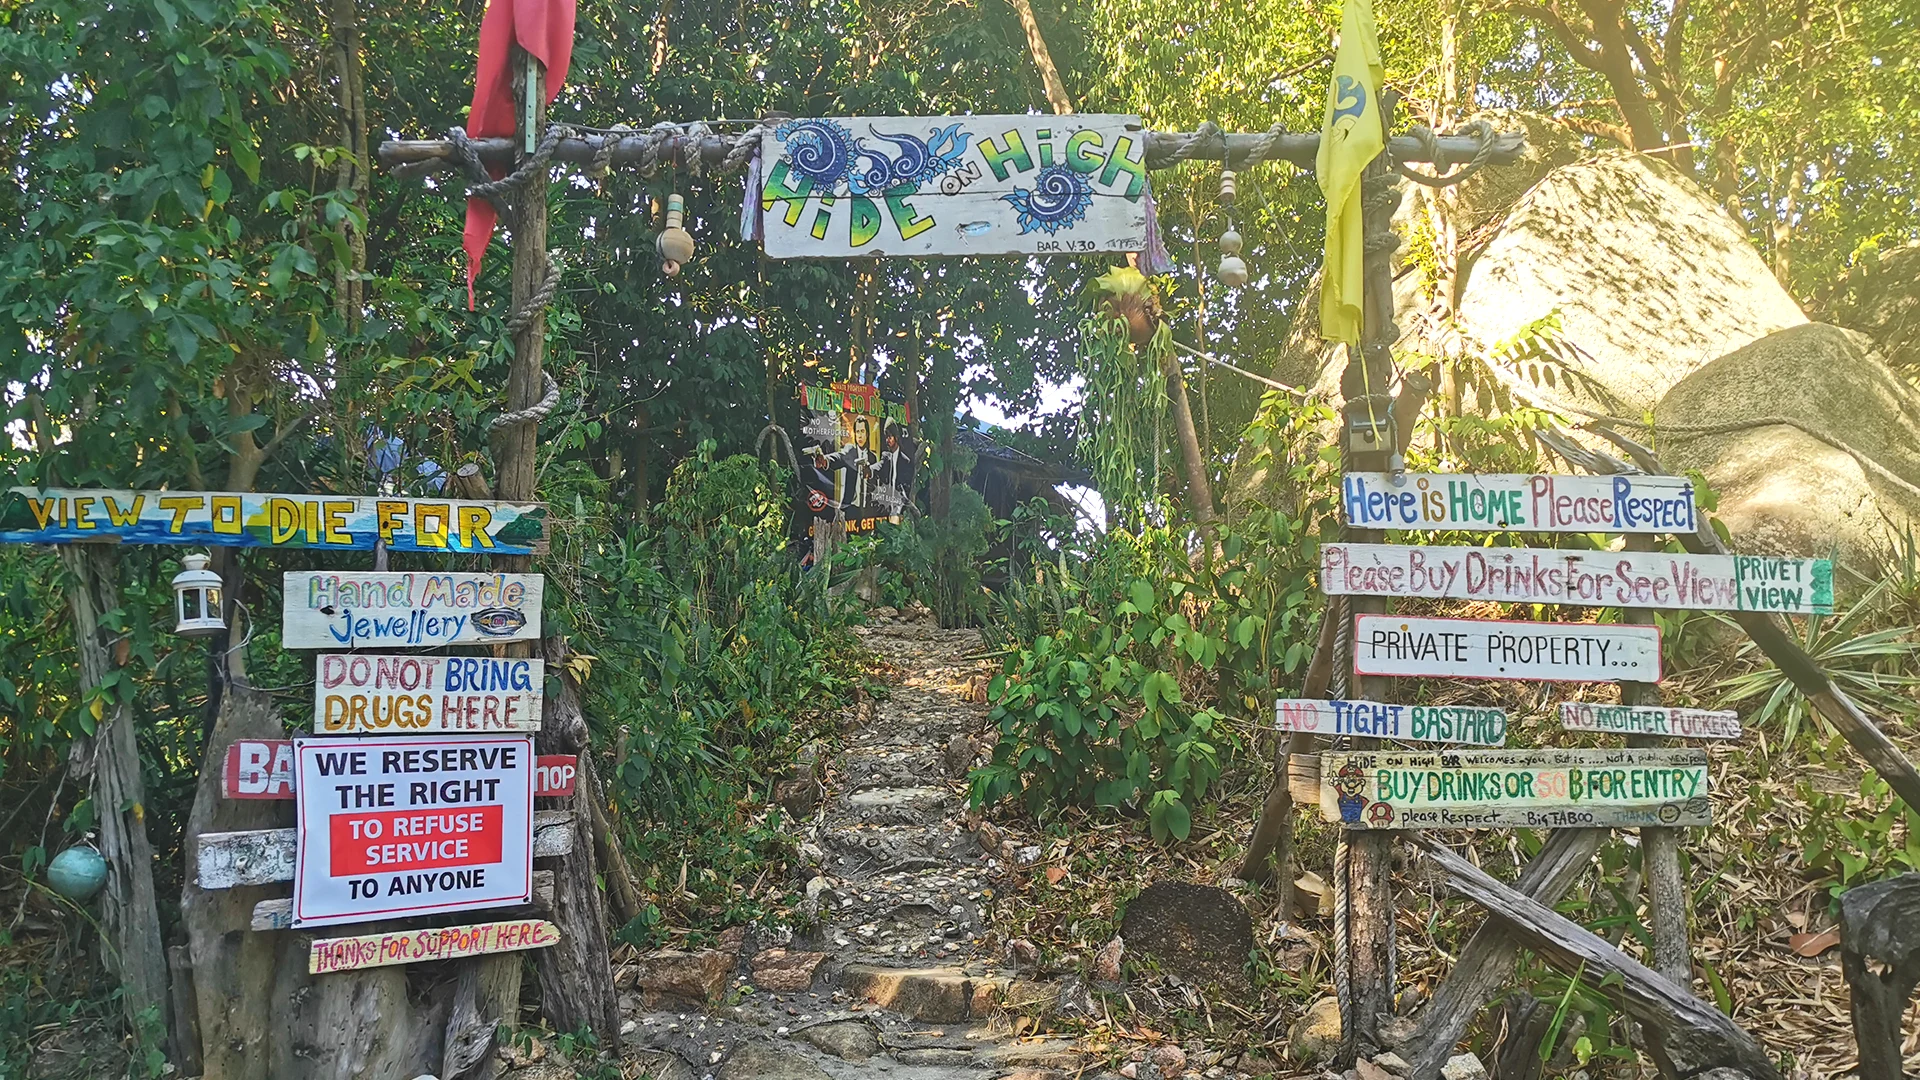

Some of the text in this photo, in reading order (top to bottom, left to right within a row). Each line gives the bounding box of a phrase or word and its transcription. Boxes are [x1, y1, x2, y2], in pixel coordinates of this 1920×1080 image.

[941, 162, 981, 196] ON
[1037, 241, 1062, 252] BAR
[849, 394, 865, 414] TO
[888, 400, 909, 426] FOR
[1344, 477, 1418, 524] Here
[1417, 477, 1446, 522] is
[1448, 480, 1526, 525] HOME
[1531, 475, 1614, 528] Please
[27, 495, 496, 549] VIEW TO DIE FOR
[861, 517, 875, 531] GET
[309, 574, 526, 609] Hand Made
[1326, 546, 1405, 592] Please
[1409, 550, 1461, 598] Buy
[1564, 556, 1614, 600] For
[1615, 560, 1670, 604] See
[1670, 560, 1738, 606] View
[1745, 581, 1803, 610] view
[323, 656, 372, 689] DO
[375, 657, 440, 692] NOT
[324, 694, 521, 731] DRUGS HERE
[1283, 702, 1320, 731] NO
[1411, 706, 1508, 745] BASTARD
[1565, 705, 1740, 736] NO MOTHER FUCKERS
[238, 742, 296, 794] BA
[316, 747, 517, 776] WE RESERVE
[1386, 757, 1403, 765] ON
[1441, 755, 1463, 768] BAR
[1573, 755, 1585, 764] is
[1627, 754, 1635, 764] A
[335, 779, 501, 809] THE RIGHT
[1377, 769, 1424, 804] BUY
[1505, 771, 1536, 799] OR
[1537, 772, 1567, 798] 50
[1587, 769, 1628, 799] FOR
[1631, 769, 1702, 799] ENTRY
[349, 813, 484, 840] TO REFUSE
[1401, 808, 1438, 827] please
[365, 839, 469, 866] SERVICE
[349, 869, 485, 900] TO ANYONE
[313, 938, 376, 973] THANKS
[379, 936, 410, 964] FOR
[413, 924, 495, 960] SUPPORT
